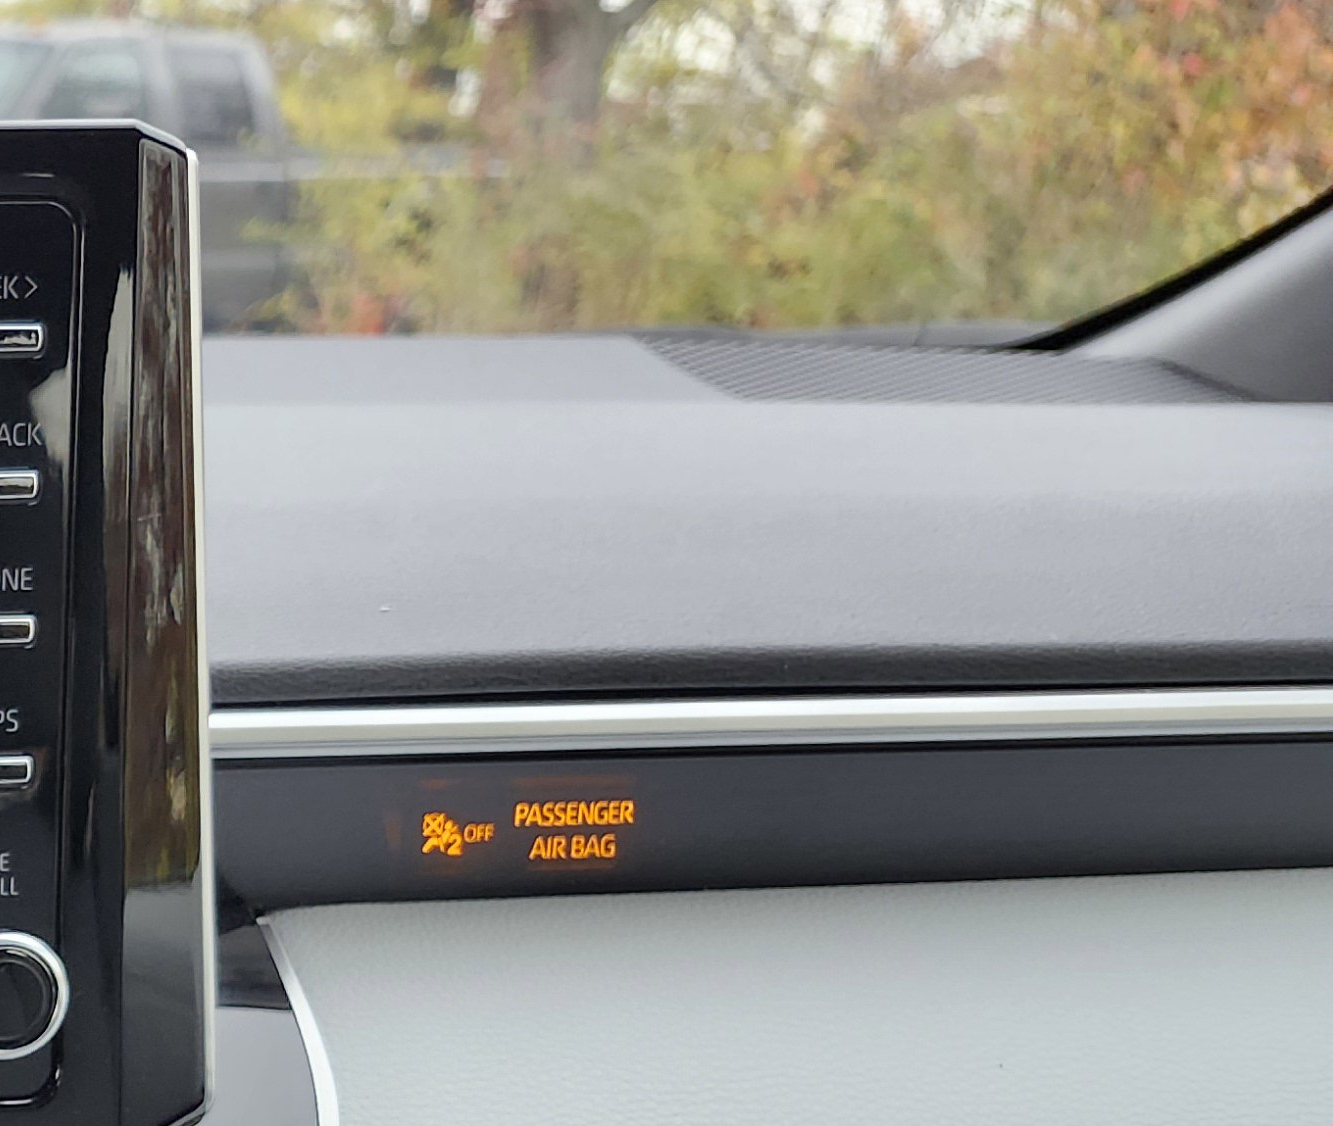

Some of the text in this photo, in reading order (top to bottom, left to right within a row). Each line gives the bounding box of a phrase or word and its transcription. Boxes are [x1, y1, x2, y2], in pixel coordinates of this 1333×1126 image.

[514, 800, 634, 827] PASSENGER
[463, 822, 494, 843] OFF
[529, 833, 616, 860] AIR BAG
